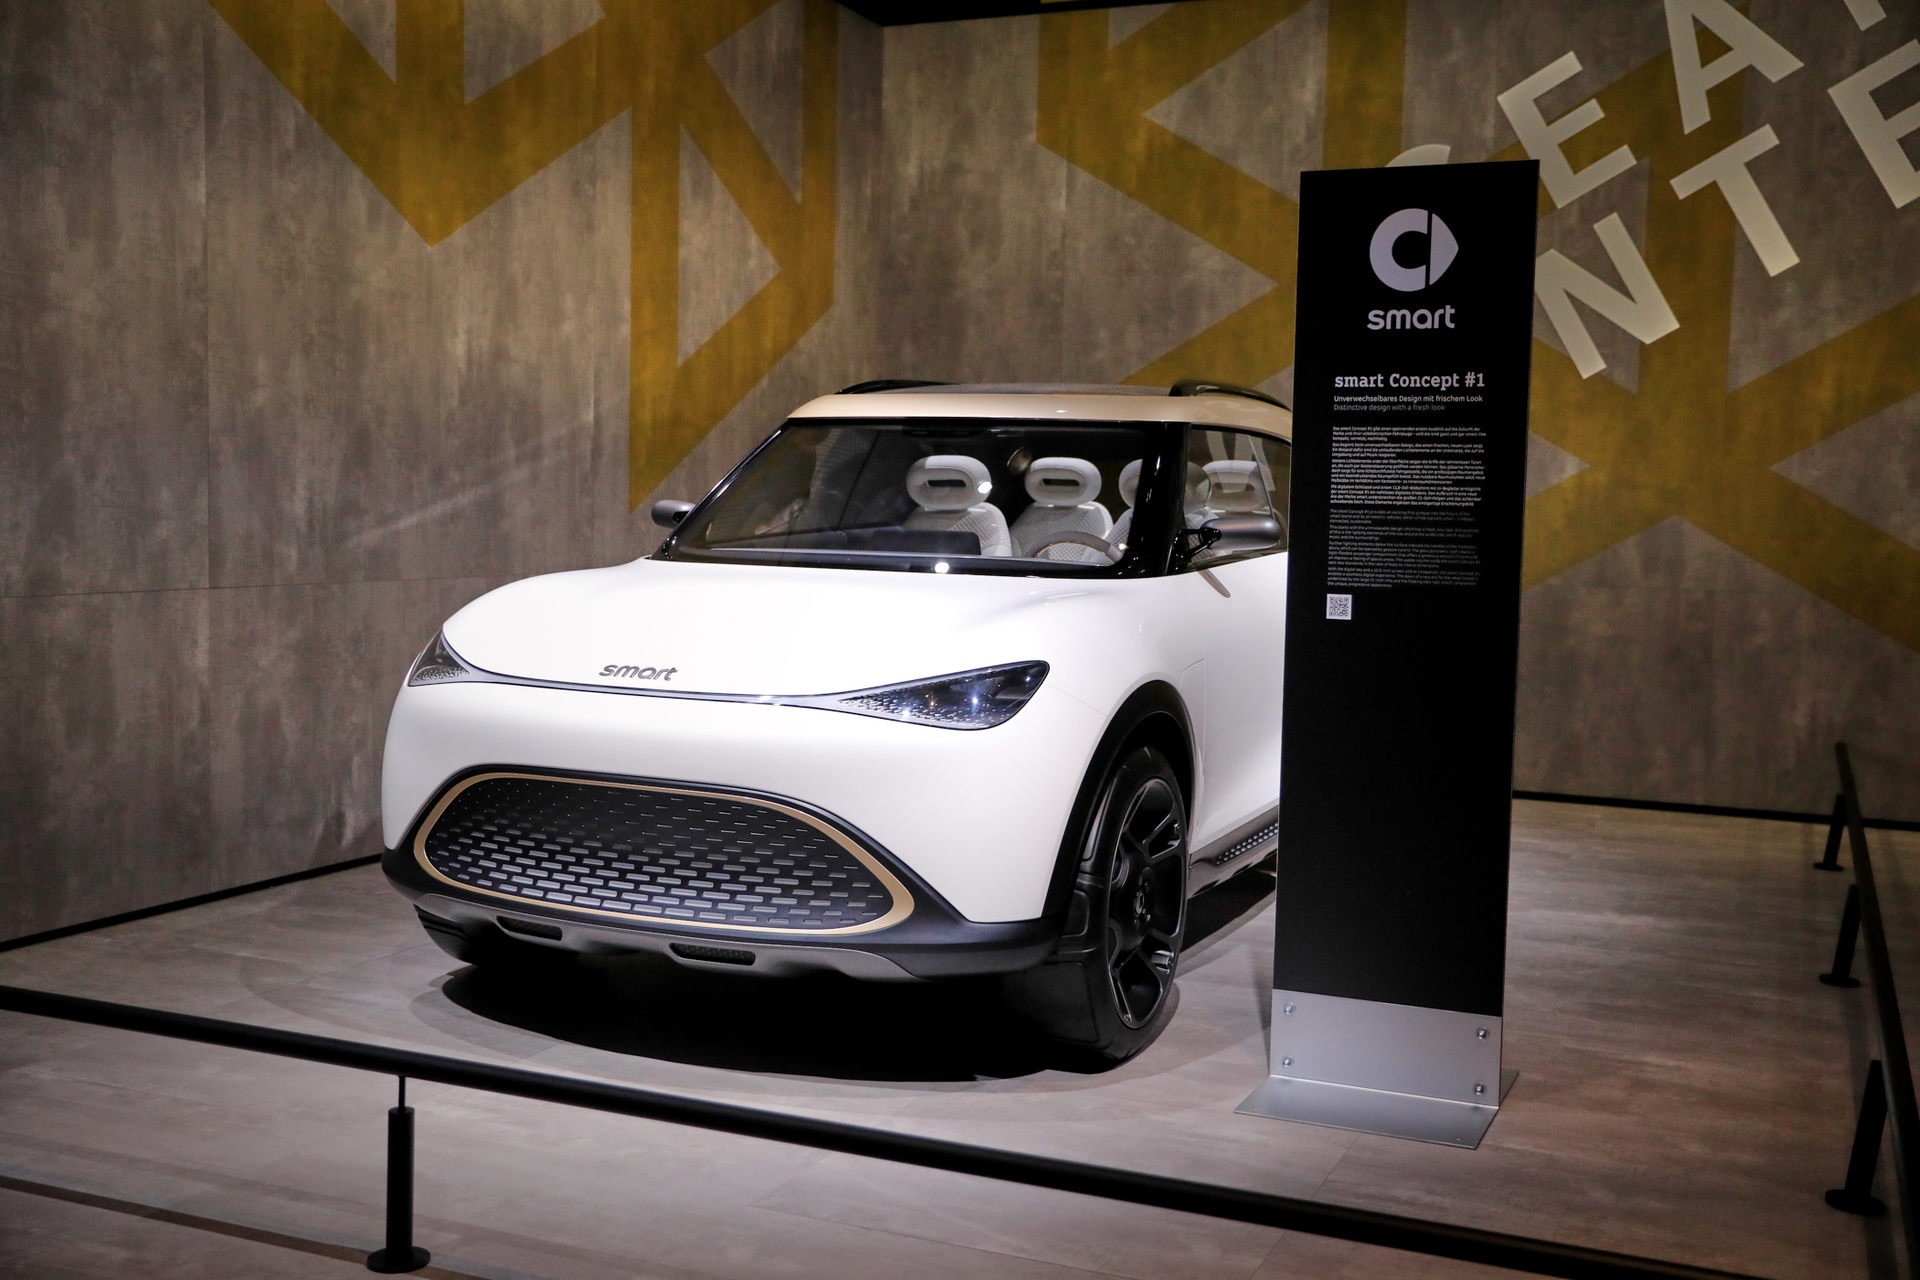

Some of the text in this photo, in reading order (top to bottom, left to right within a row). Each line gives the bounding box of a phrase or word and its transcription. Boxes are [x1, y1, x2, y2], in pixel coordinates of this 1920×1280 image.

[1366, 304, 1456, 330] smart
[1334, 371, 1485, 391] smart Concept #1
[1333, 394, 1398, 403] Unverwechselbares
[1399, 394, 1422, 404] Design
[1423, 395, 1435, 403] mit
[1466, 395, 1484, 403] Look
[598, 664, 679, 682] smart
